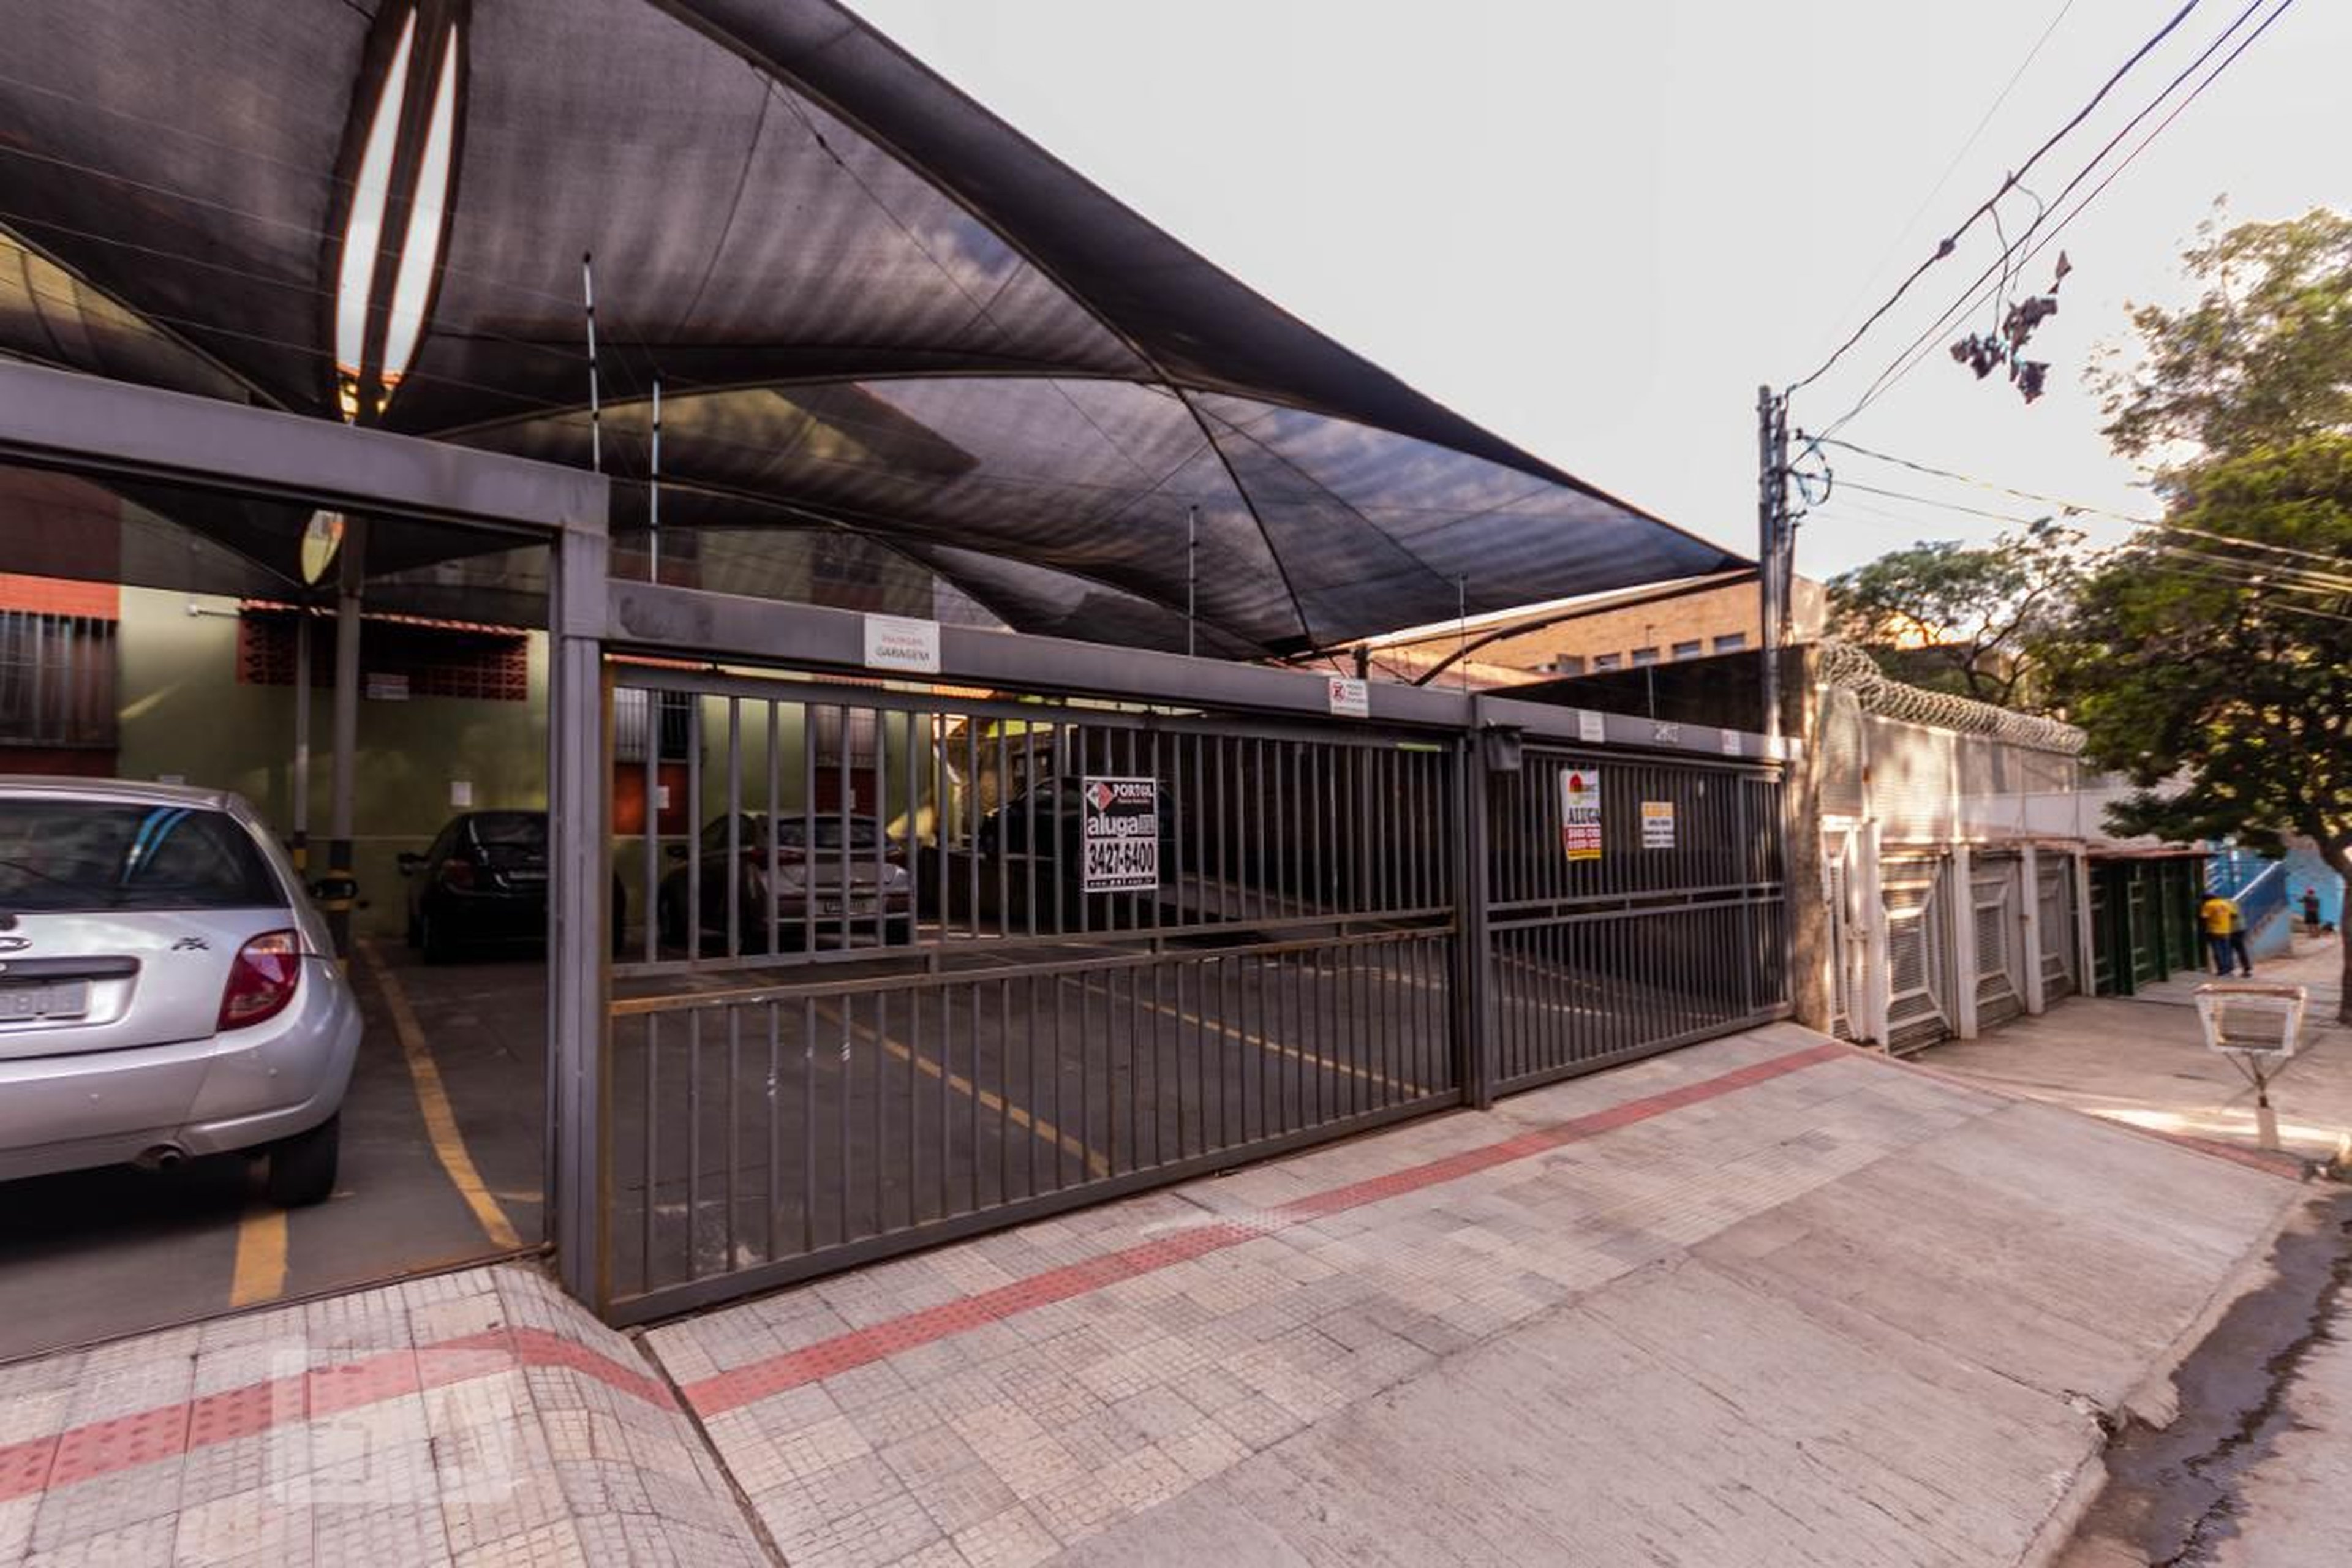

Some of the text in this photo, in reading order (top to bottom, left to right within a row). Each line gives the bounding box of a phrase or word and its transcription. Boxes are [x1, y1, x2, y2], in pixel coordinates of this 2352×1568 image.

[875, 646, 930, 662] GARAGEM
[1087, 812, 1139, 837] aluga
[1089, 842, 1154, 875] 3427-6400
